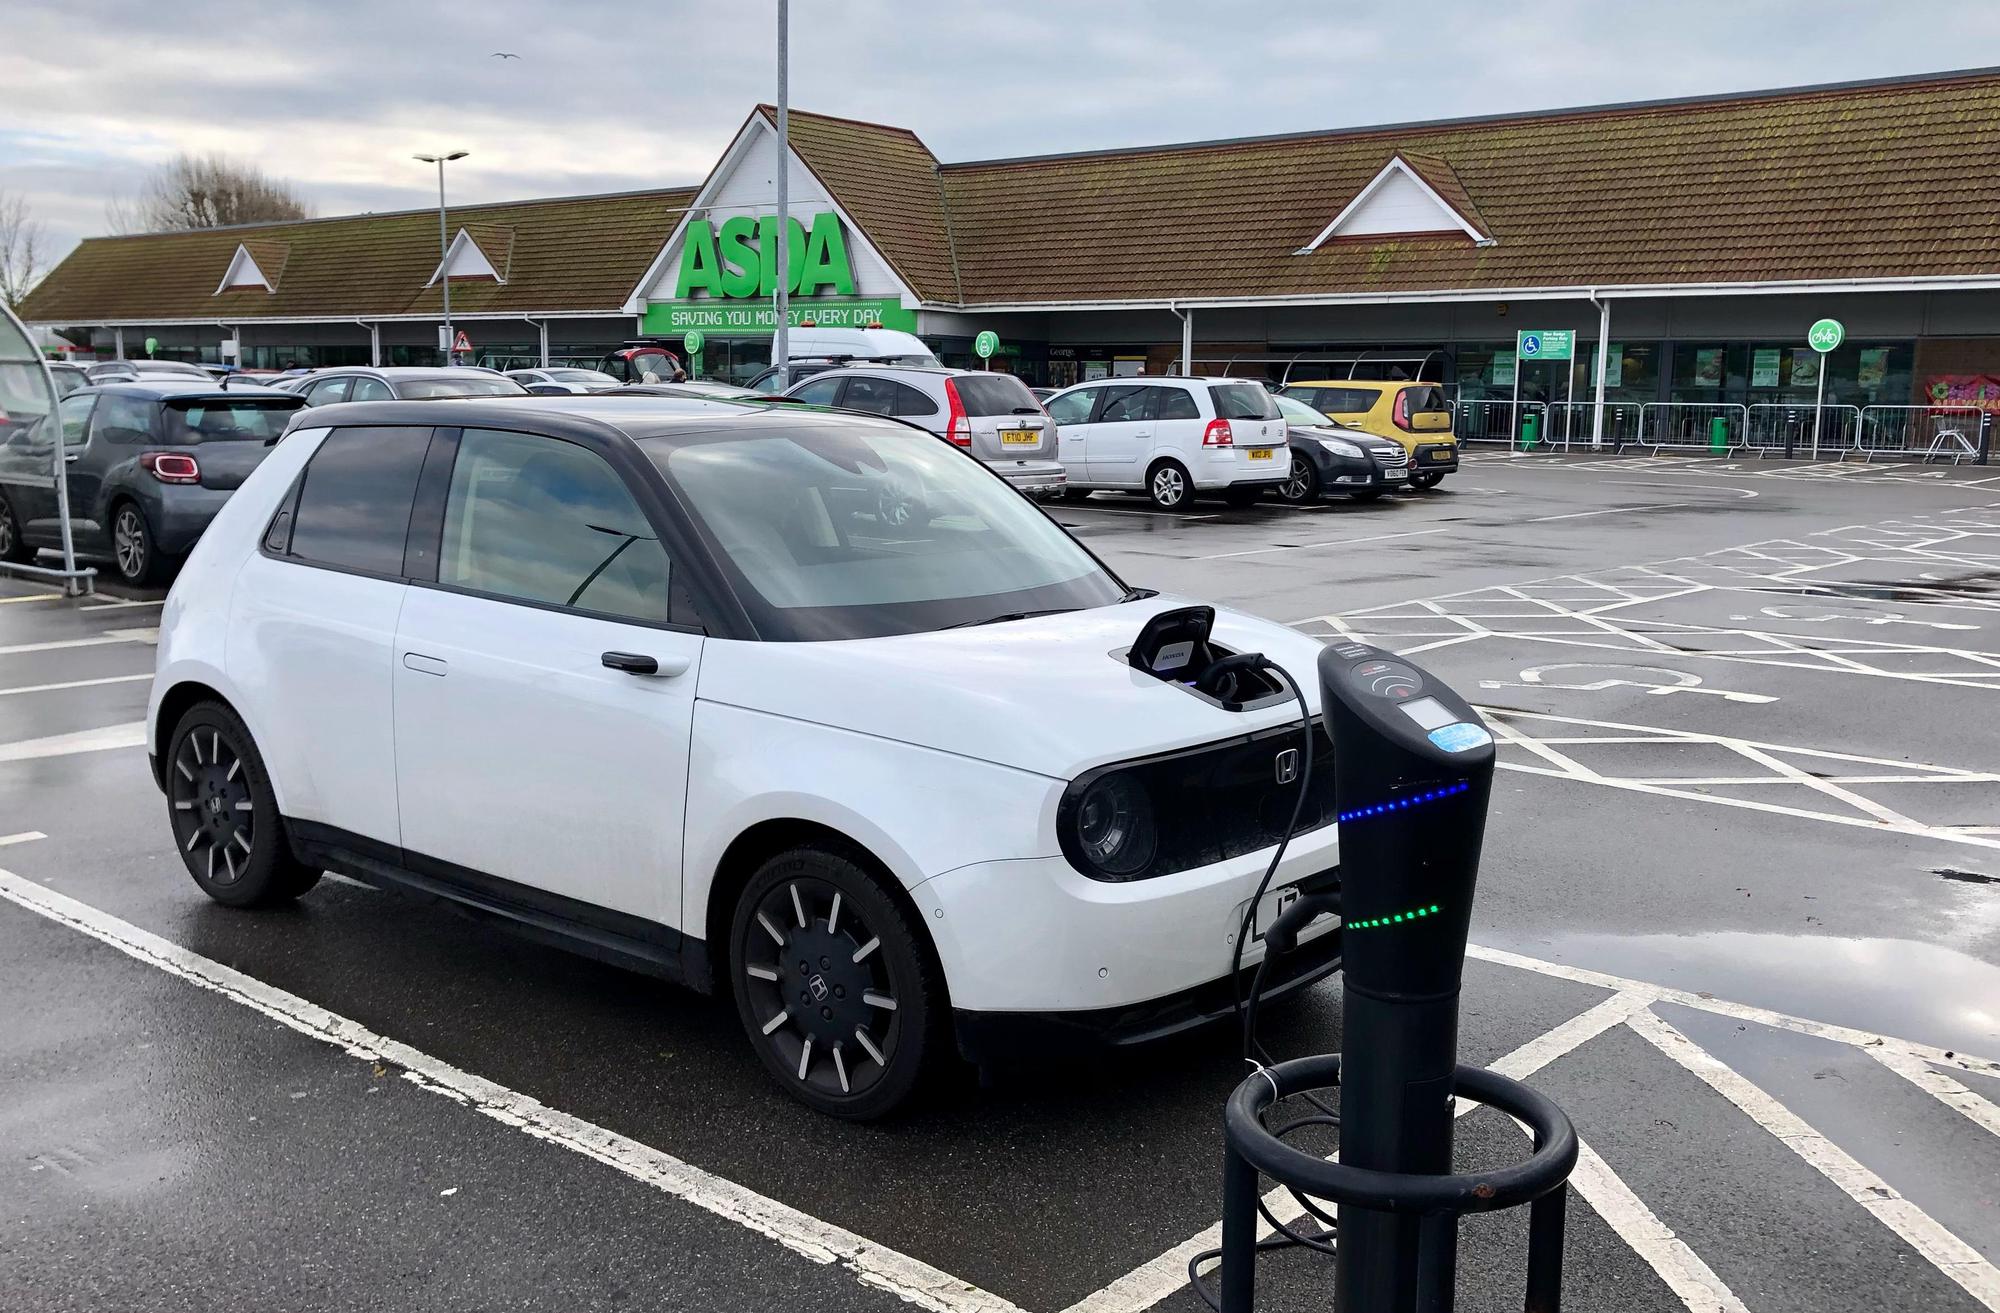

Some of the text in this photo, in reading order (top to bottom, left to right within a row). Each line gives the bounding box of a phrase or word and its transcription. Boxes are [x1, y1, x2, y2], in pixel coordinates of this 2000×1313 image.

[675, 212, 856, 299] ASDA
[671, 311, 722, 326] SAVING
[725, 311, 751, 325] YOU
[804, 309, 850, 324] EVERY
[853, 309, 883, 324] DAY
